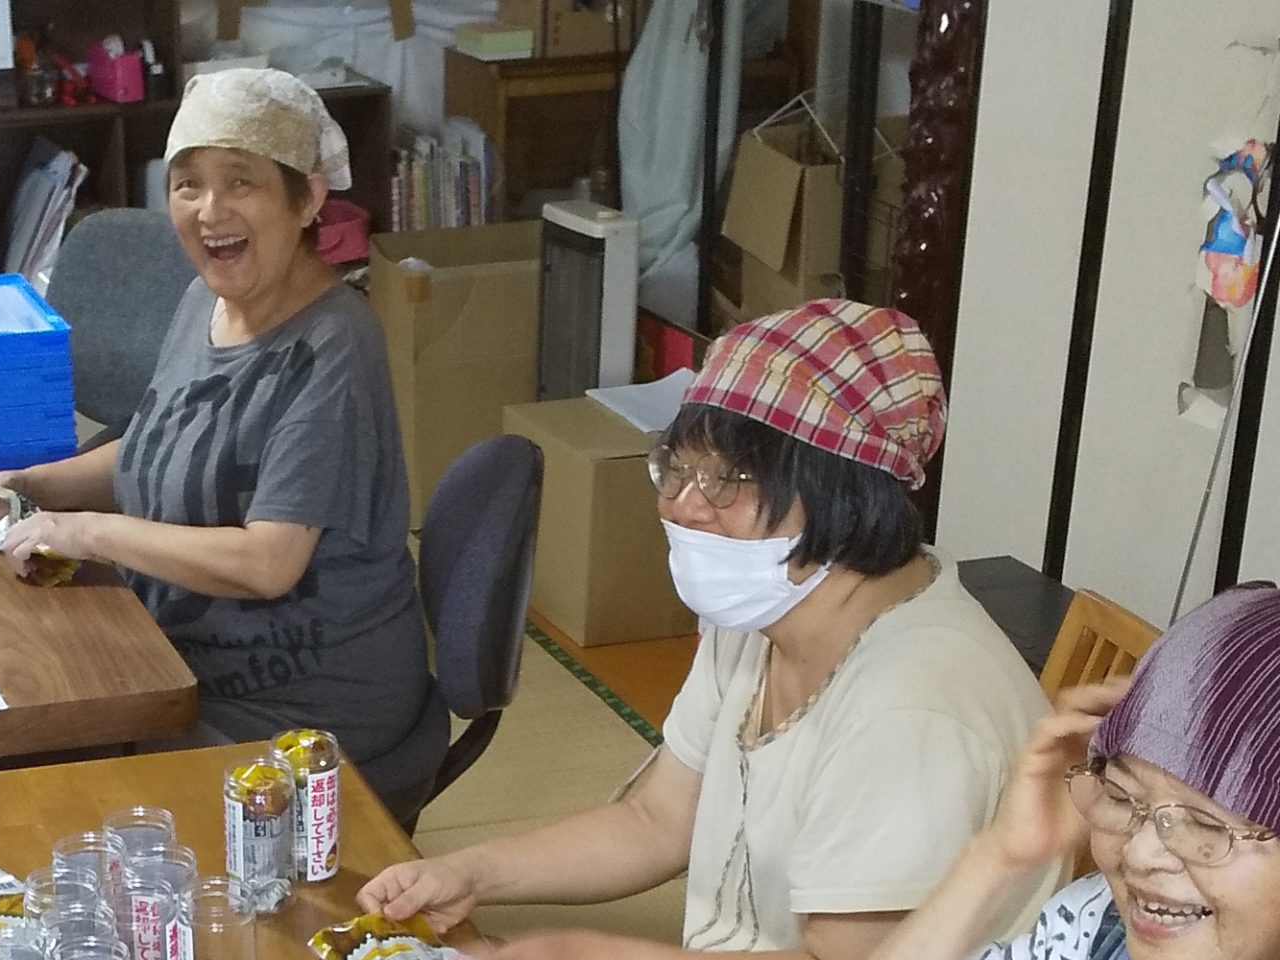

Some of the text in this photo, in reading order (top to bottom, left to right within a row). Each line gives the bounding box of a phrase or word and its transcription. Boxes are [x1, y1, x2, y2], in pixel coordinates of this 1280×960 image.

[311, 778, 326, 877] 返却して下さい
[326, 773, 337, 840] 缶は必ず
